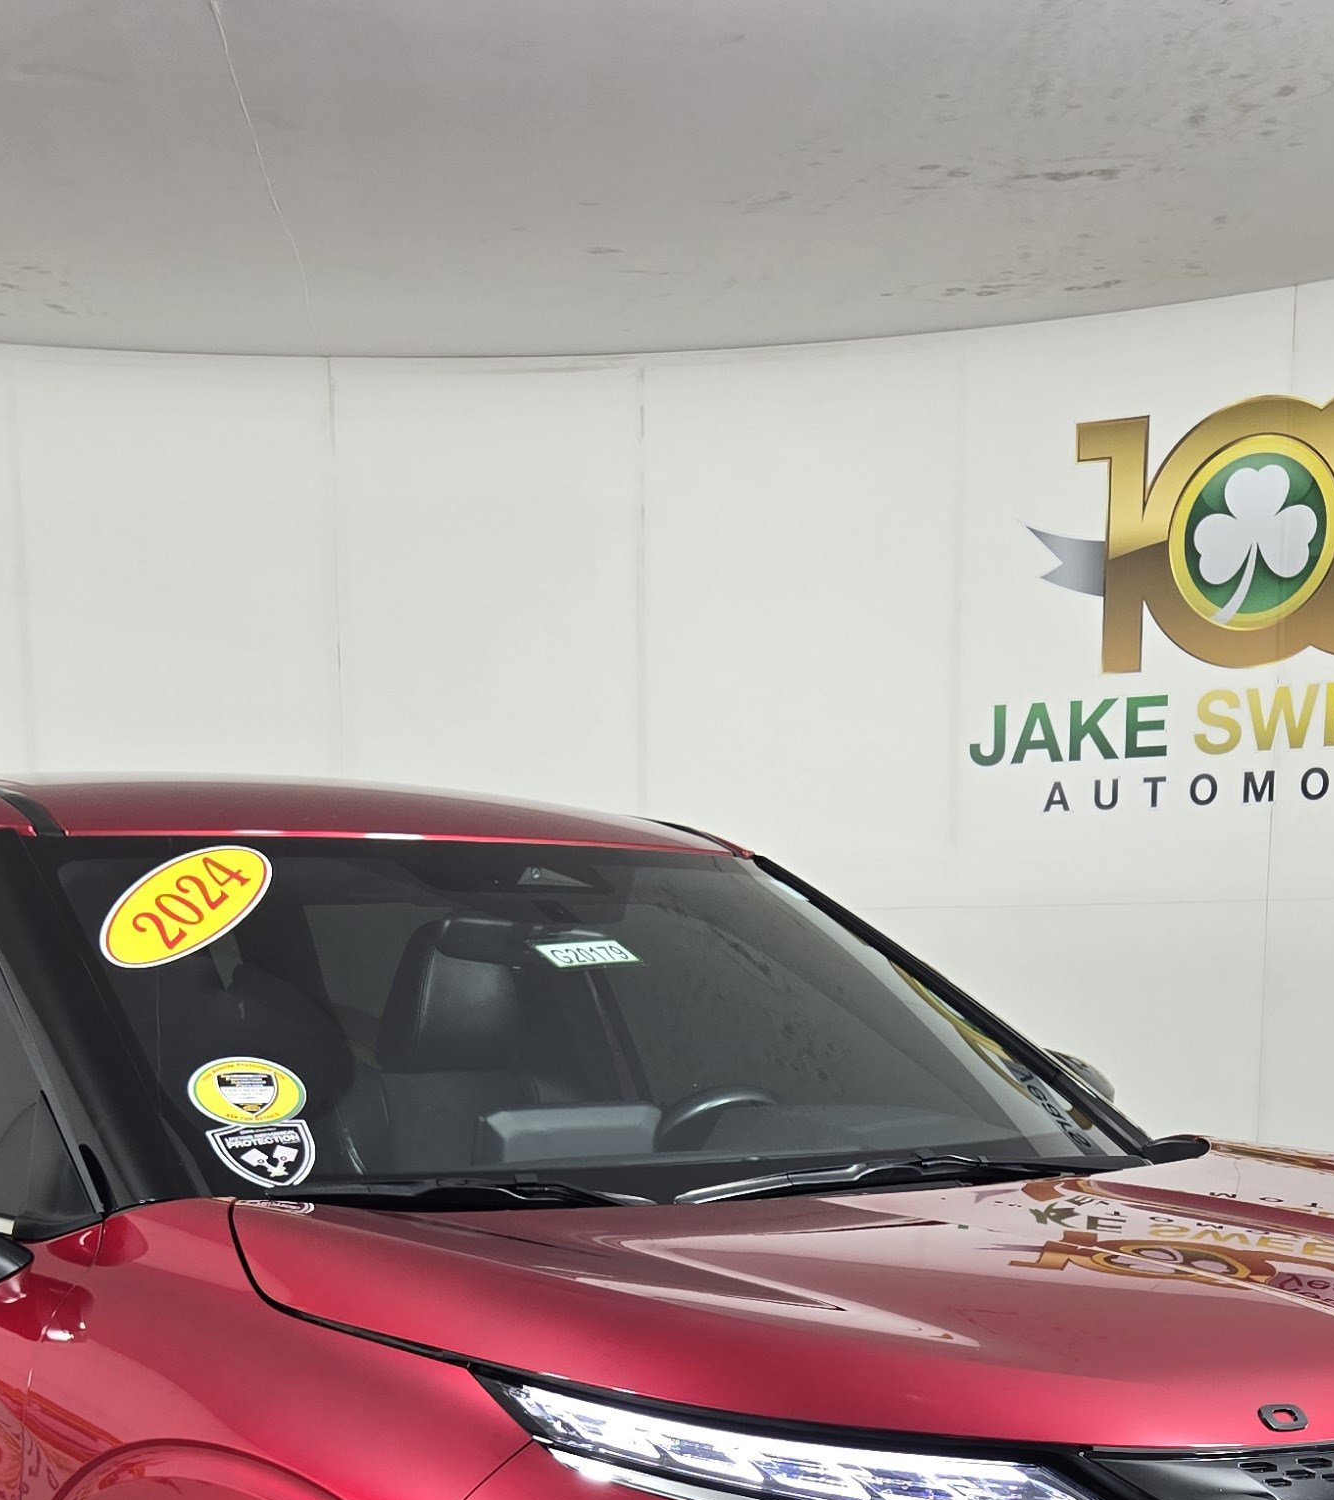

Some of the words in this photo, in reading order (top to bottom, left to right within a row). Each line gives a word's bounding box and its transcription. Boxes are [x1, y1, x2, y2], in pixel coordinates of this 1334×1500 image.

[969, 694, 1169, 768] JAKE
[131, 856, 252, 950] 2024
[549, 945, 630, 965] G20179
[227, 1134, 300, 1149] PROTECTION
